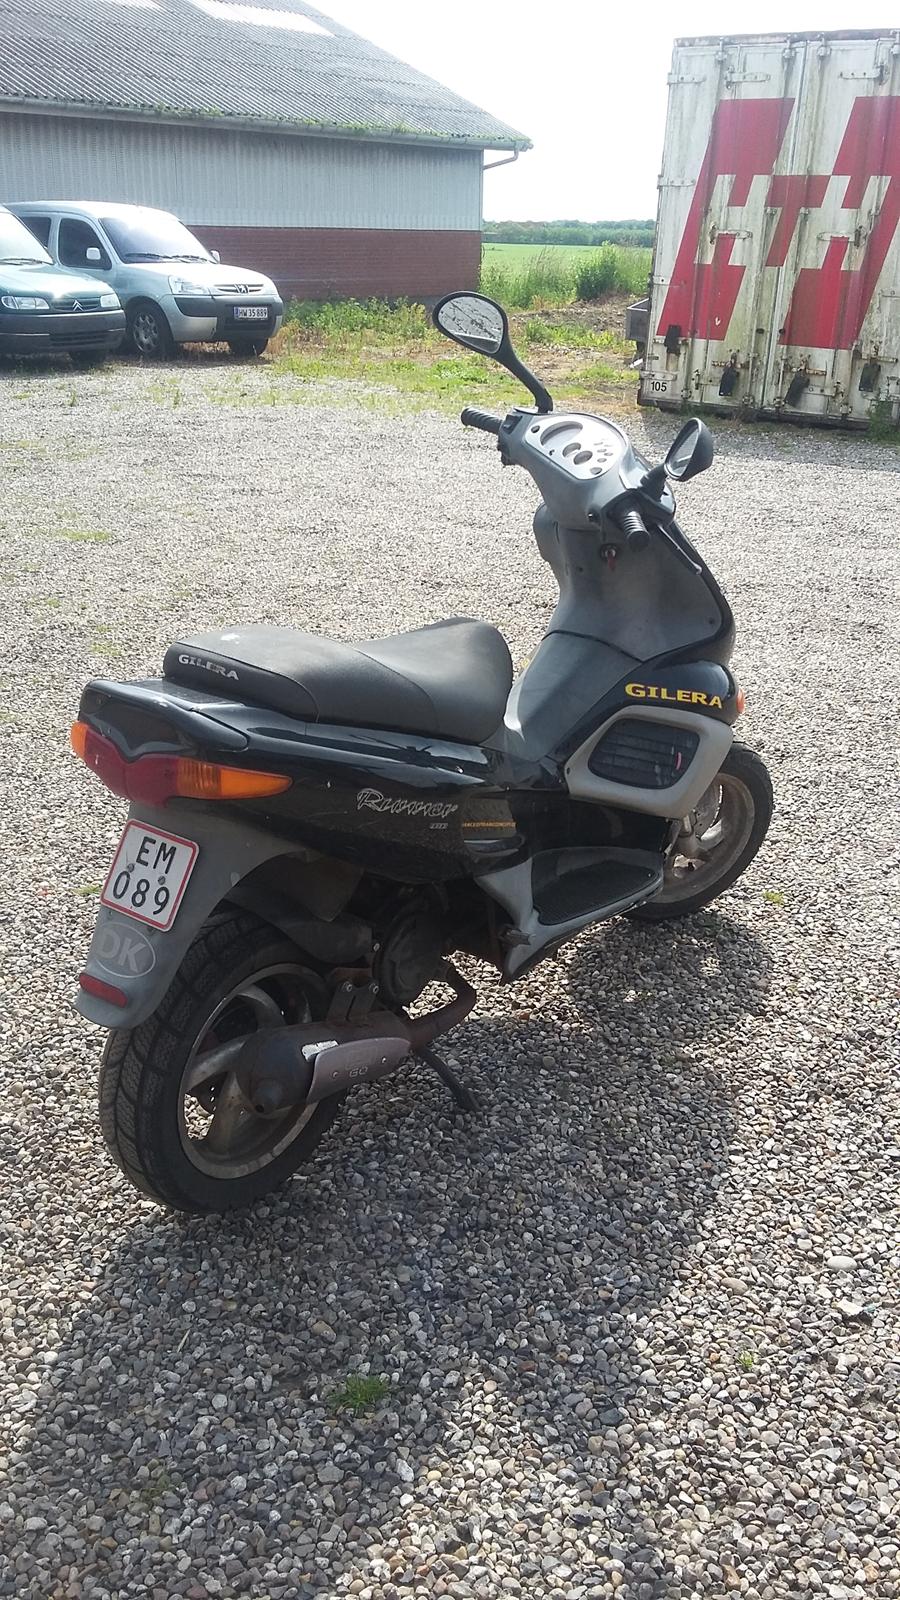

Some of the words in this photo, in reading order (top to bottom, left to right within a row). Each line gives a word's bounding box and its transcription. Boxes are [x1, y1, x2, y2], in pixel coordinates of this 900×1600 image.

[651, 381, 667, 392] 105
[178, 654, 239, 681] GILERA
[625, 683, 723, 709] GILERA
[357, 788, 458, 818] Runner
[136, 836, 177, 875] EM
[112, 870, 170, 915] 089
[98, 927, 147, 973] DK
